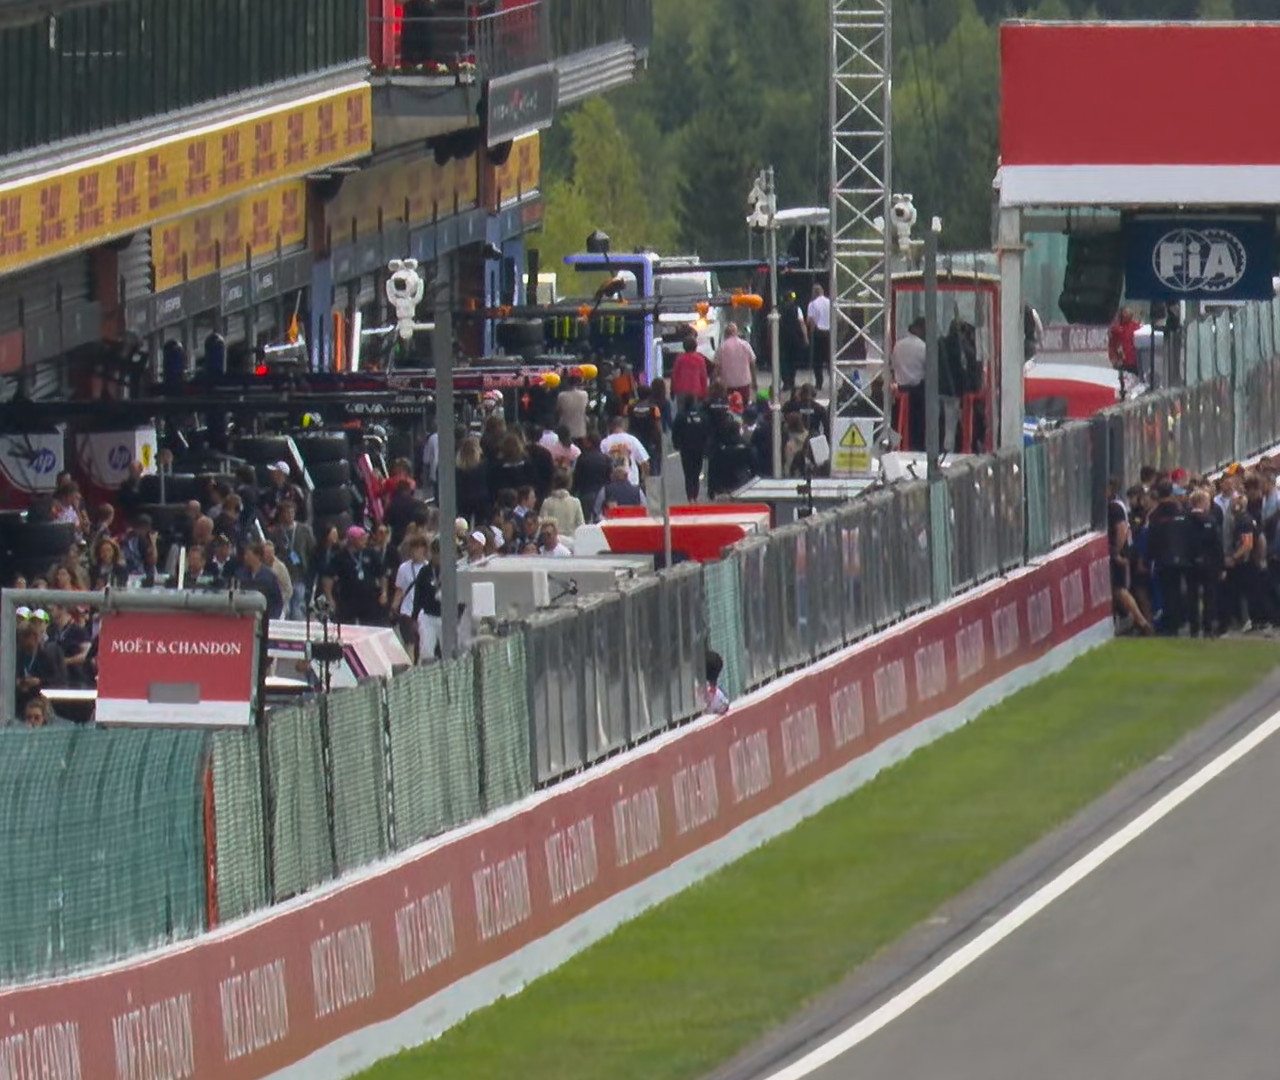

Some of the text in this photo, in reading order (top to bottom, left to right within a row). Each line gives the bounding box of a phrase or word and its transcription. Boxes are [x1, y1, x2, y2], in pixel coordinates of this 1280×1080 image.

[111, 638, 242, 655] MOËT & CHANDON
